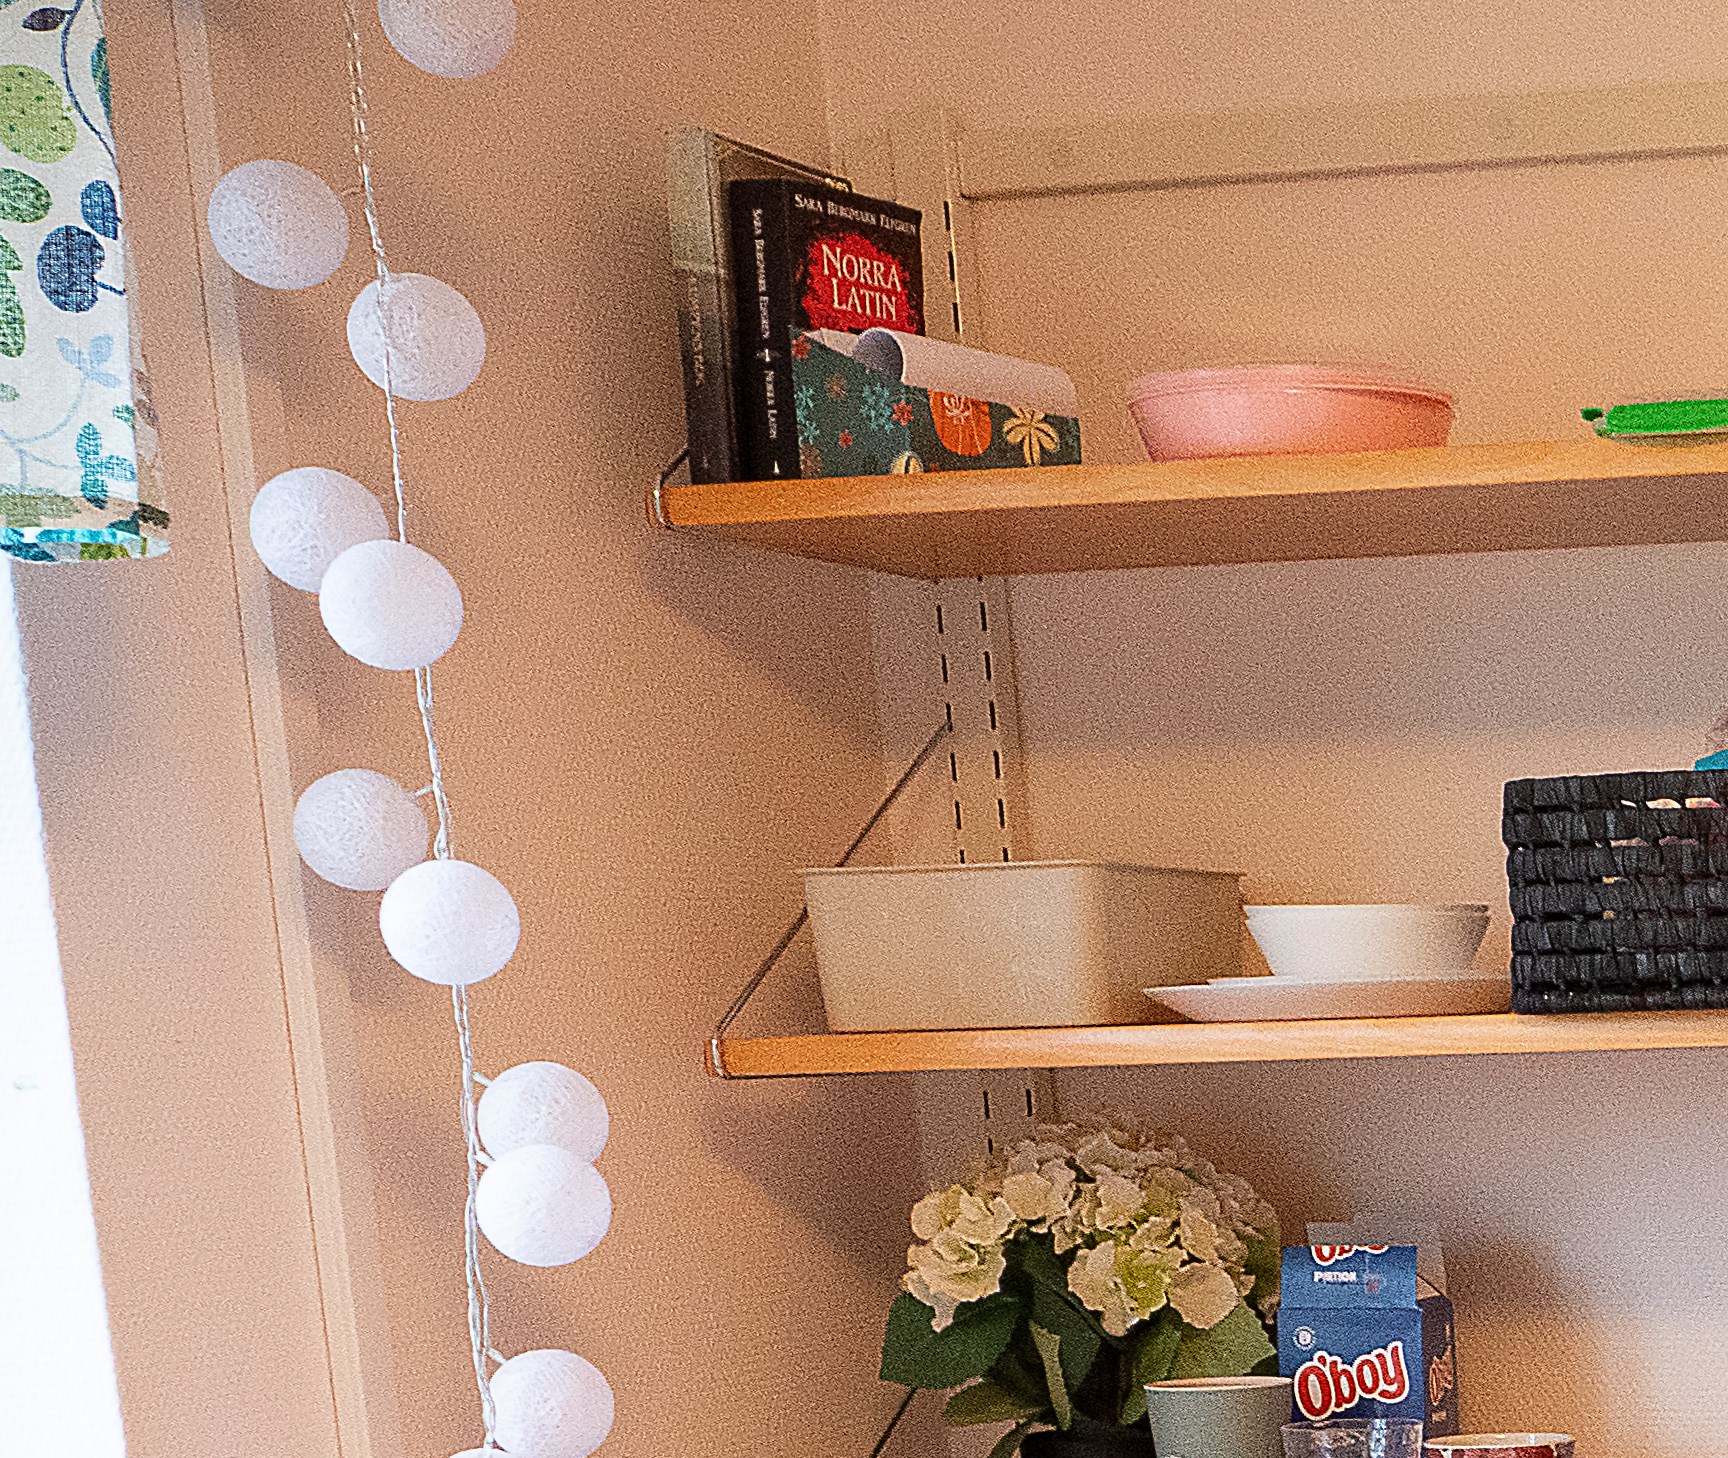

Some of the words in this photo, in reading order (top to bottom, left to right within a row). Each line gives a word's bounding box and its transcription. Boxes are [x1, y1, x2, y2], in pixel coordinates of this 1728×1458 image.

[821, 243, 901, 291] NORRA
[831, 277, 897, 320] LATIN
[1295, 1341, 1409, 1421] O'boy
